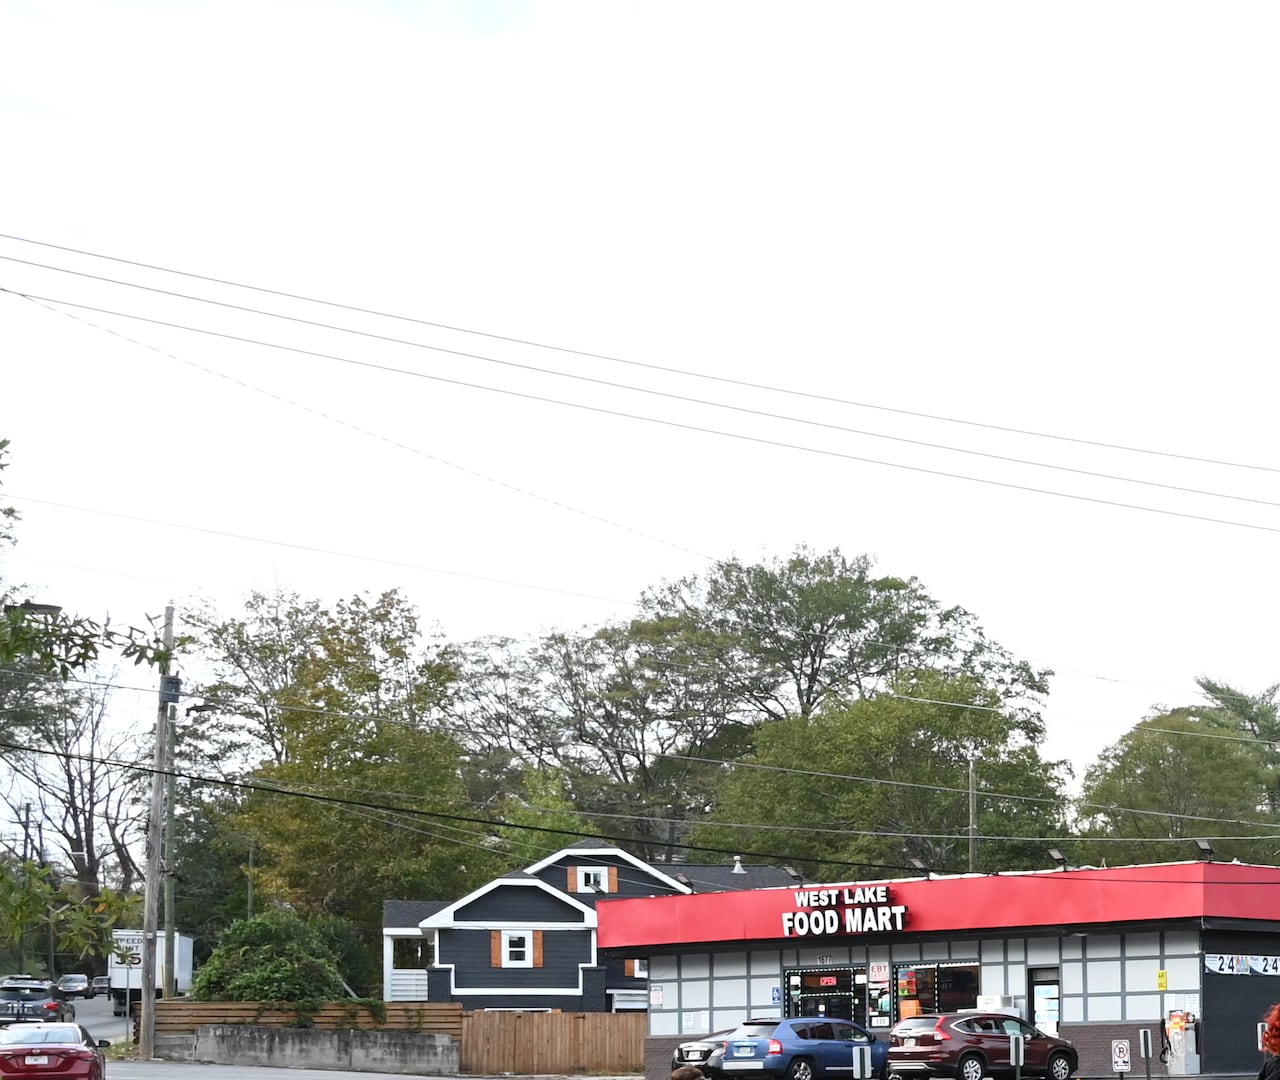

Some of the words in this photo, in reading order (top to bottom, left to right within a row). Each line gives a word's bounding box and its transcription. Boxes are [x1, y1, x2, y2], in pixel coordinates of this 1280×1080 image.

[795, 889, 839, 907] WEST
[844, 886, 888, 904] LAKE
[781, 909, 839, 936] FOOD
[845, 905, 906, 933] MART
[871, 965, 887, 973] EBT
